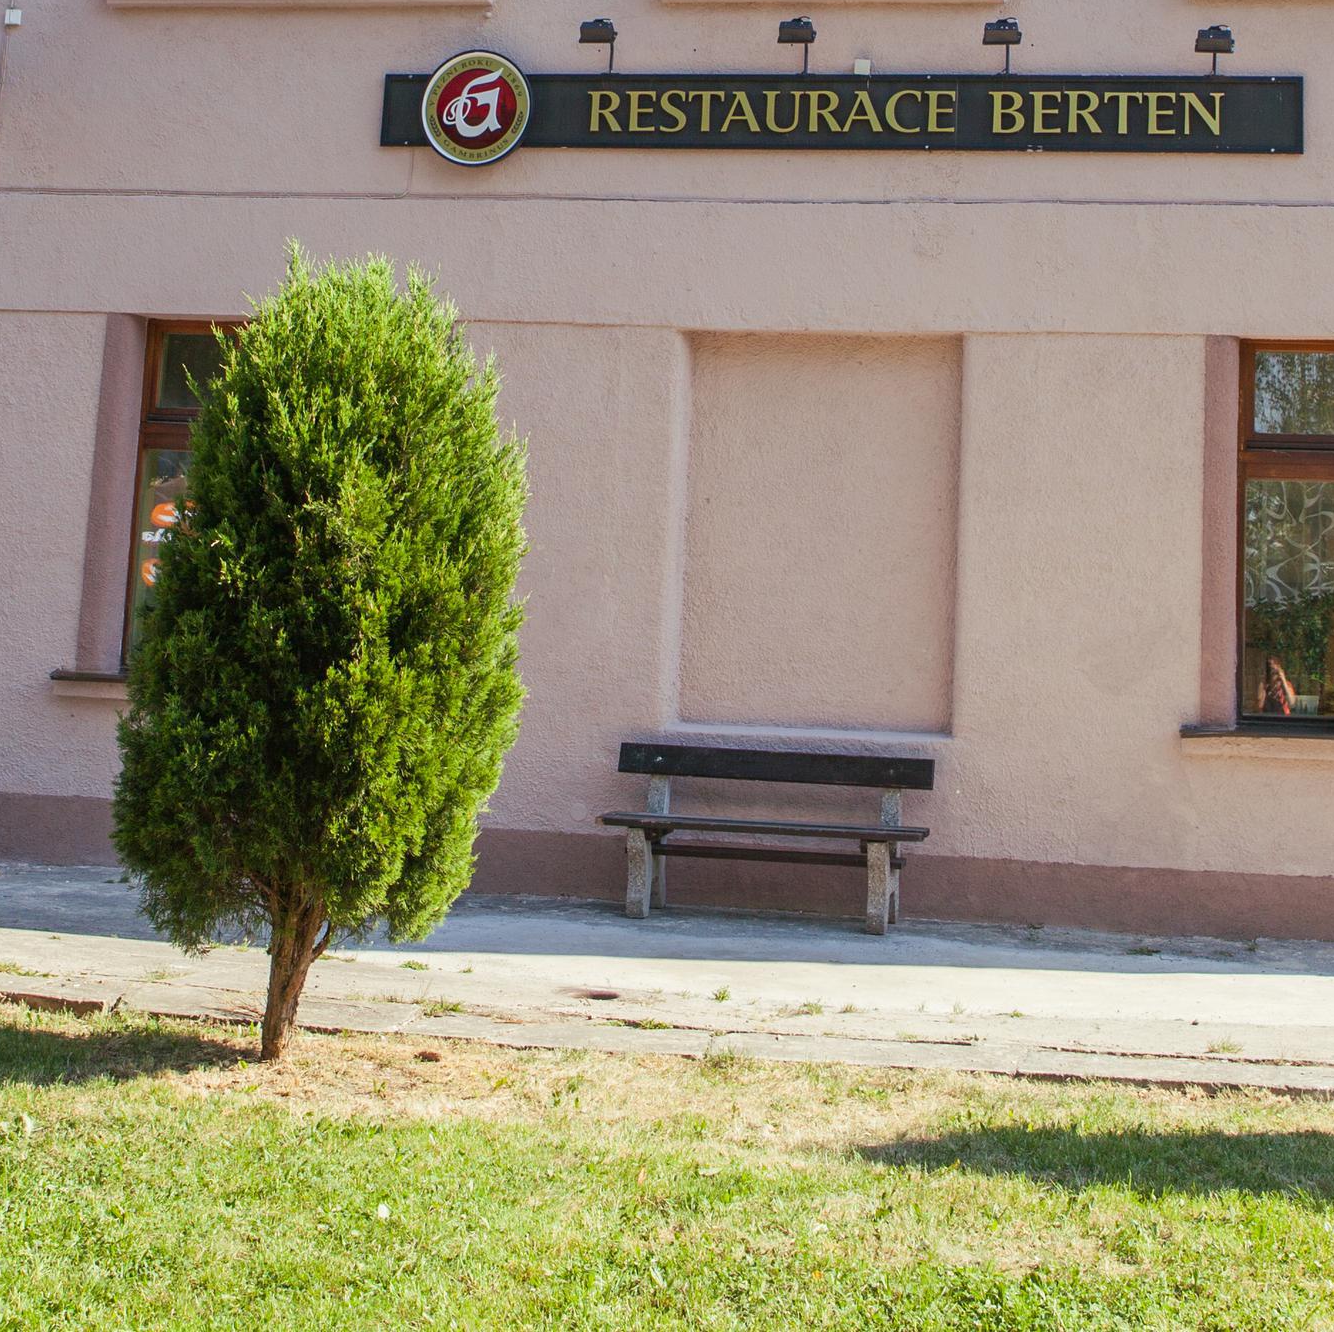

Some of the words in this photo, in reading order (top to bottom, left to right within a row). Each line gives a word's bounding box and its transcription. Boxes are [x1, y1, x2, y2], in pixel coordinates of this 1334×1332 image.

[462, 59, 493, 69] ROKU
[587, 89, 956, 134] RESTAURACE
[989, 90, 1226, 136] BERTEN
[443, 139, 509, 159] GAMBRINUS
